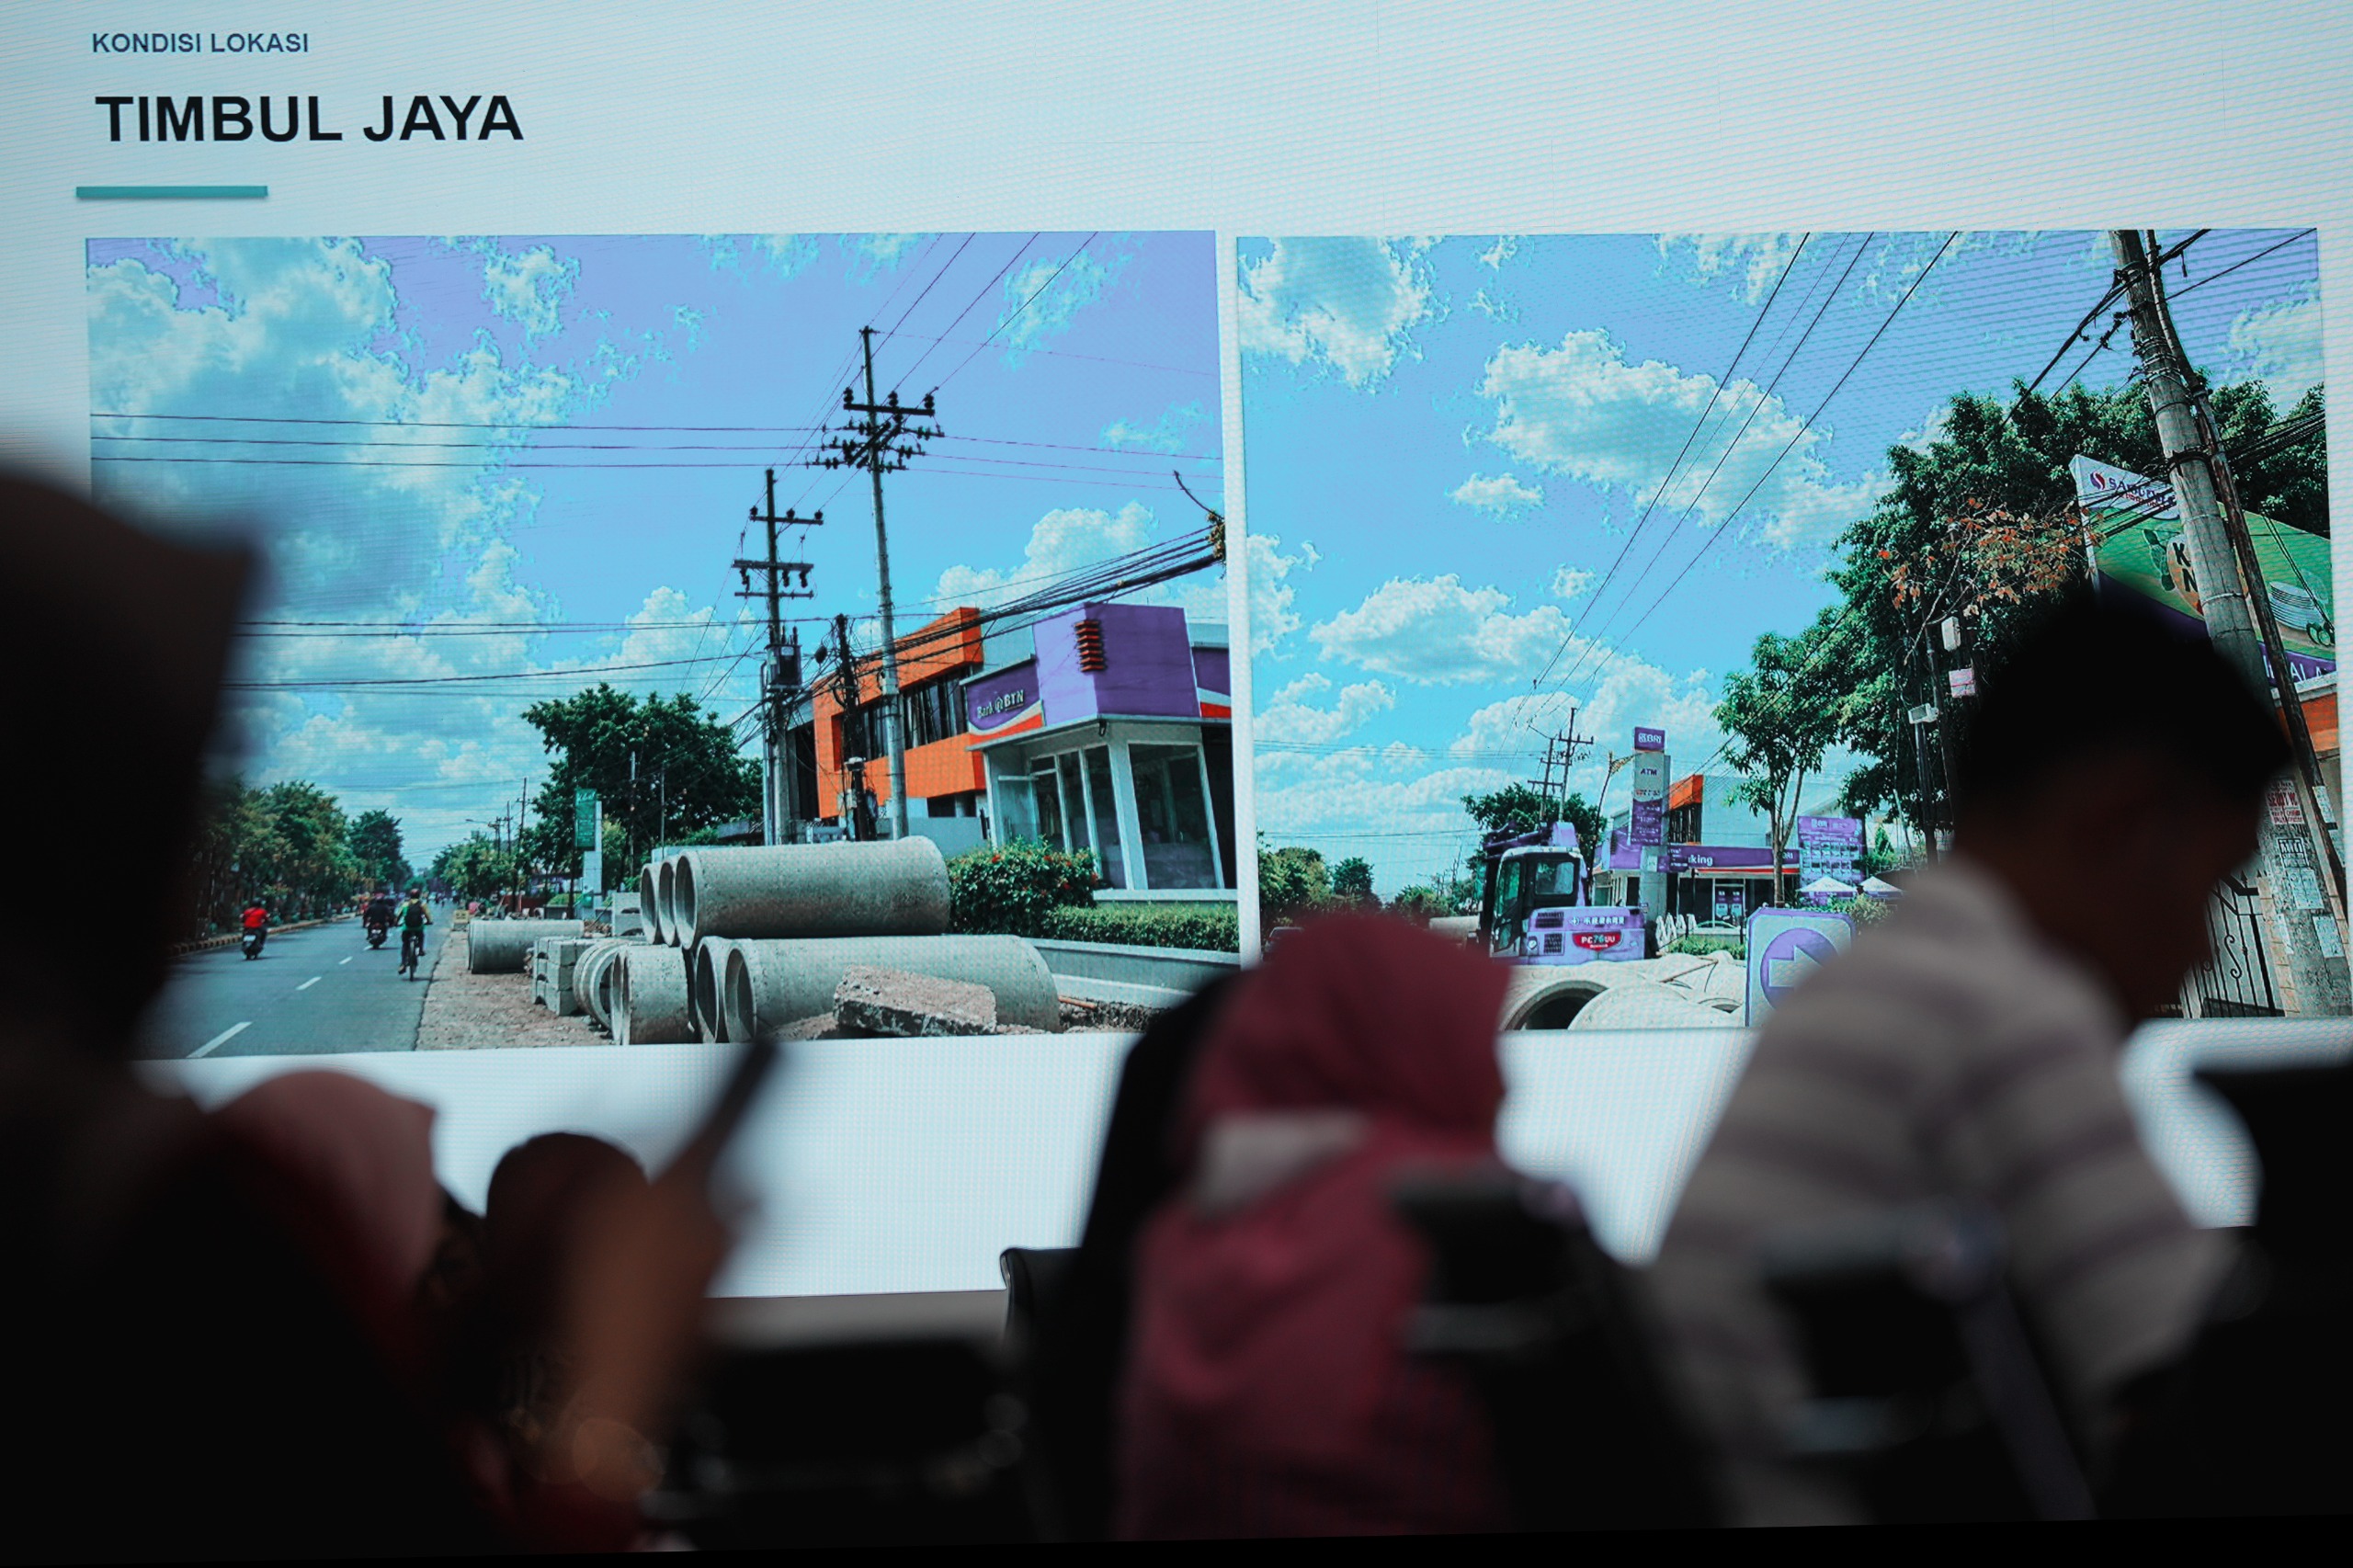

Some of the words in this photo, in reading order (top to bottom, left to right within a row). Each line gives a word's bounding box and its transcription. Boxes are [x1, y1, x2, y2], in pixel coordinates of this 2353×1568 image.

[92, 33, 201, 53] KONDISI
[212, 33, 309, 53] LOKASI
[96, 95, 343, 142] TIMBUL
[363, 95, 524, 142] JAYA
[1641, 768, 1657, 777] ATM
